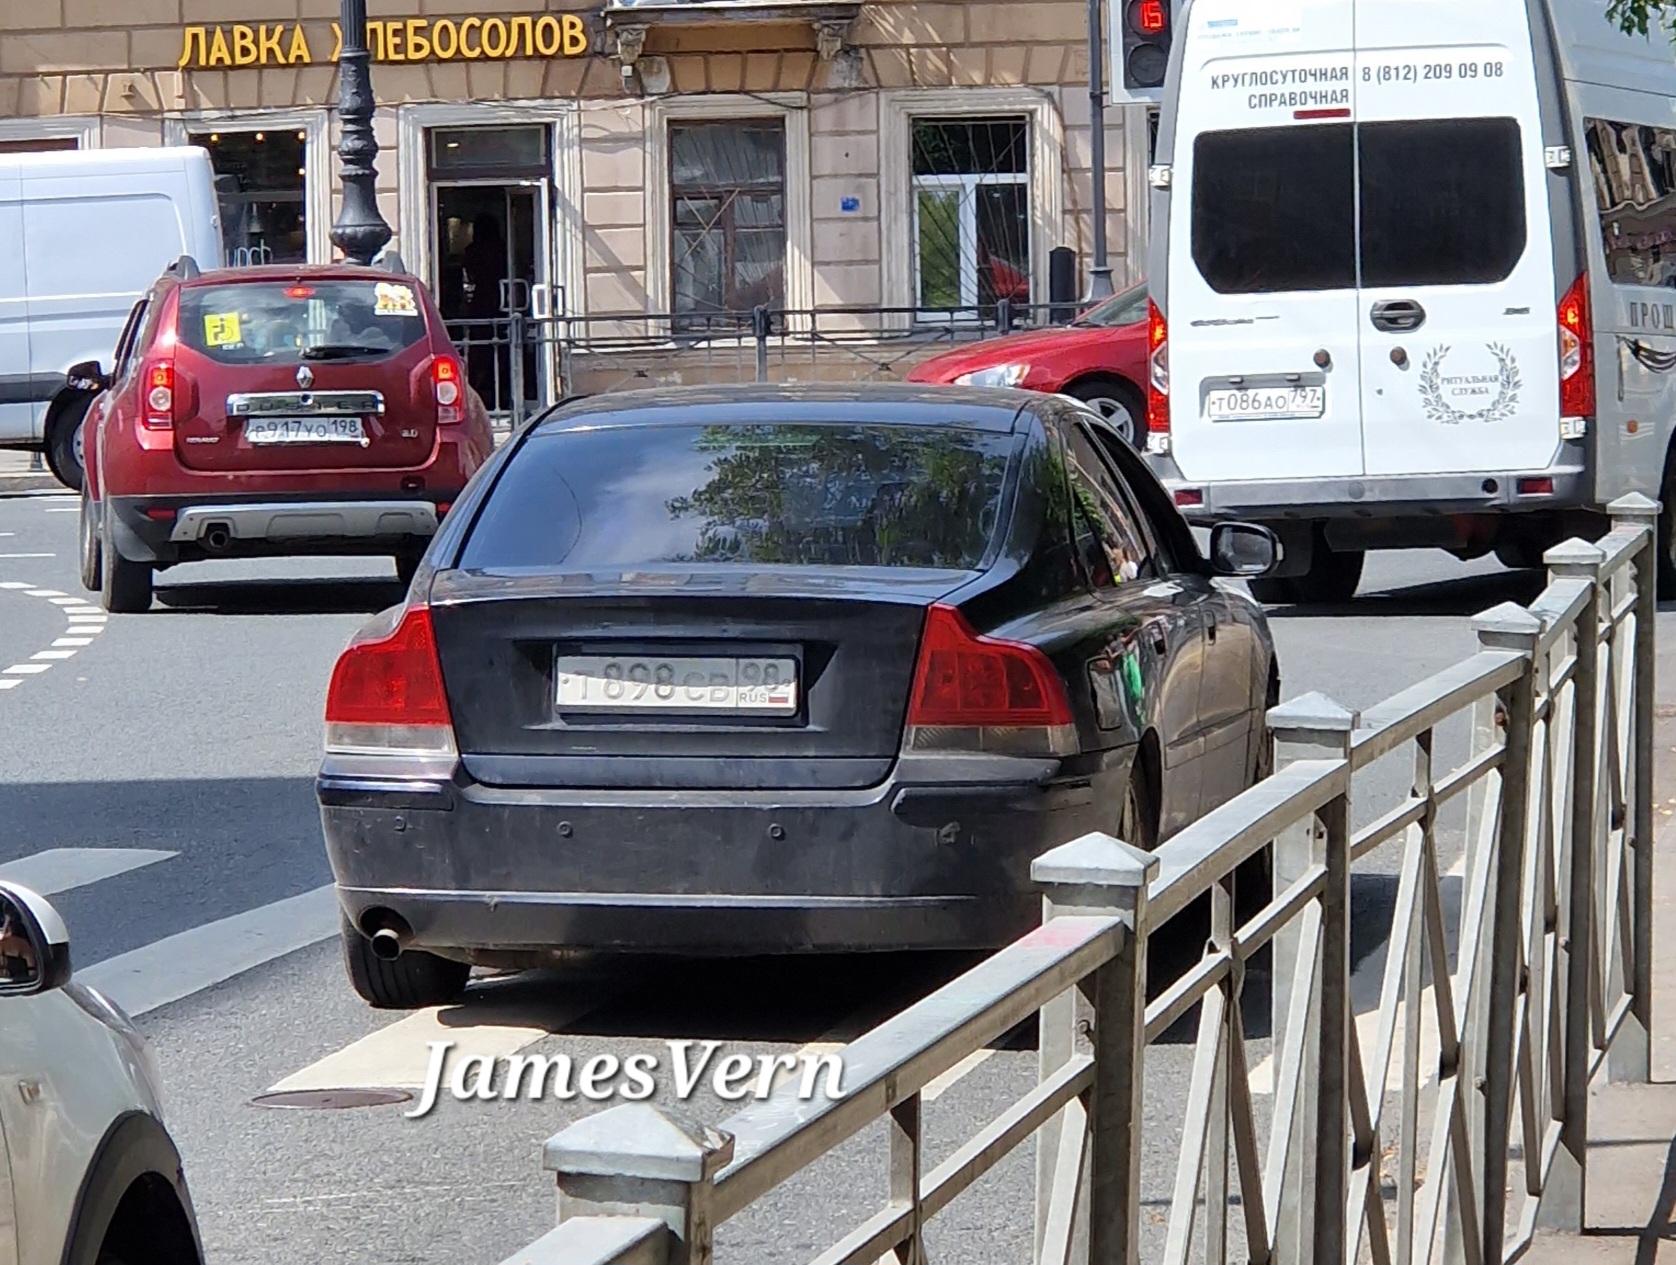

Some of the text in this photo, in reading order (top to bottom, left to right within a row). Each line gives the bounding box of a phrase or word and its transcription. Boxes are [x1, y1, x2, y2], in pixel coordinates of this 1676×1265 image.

[1143, 1, 1163, 28] 15
[178, 23, 311, 67] ЛАВКА
[1211, 61, 1504, 90] КРУГЛОСУТОЧНАЯ 8 (812) 209 09 08
[1248, 88, 1349, 110] СПРАВОЧНАЯ
[1290, 388, 1317, 404] 797
[331, 419, 358, 434] 198
[743, 662, 780, 692] 98
[739, 692, 767, 703] RUS
